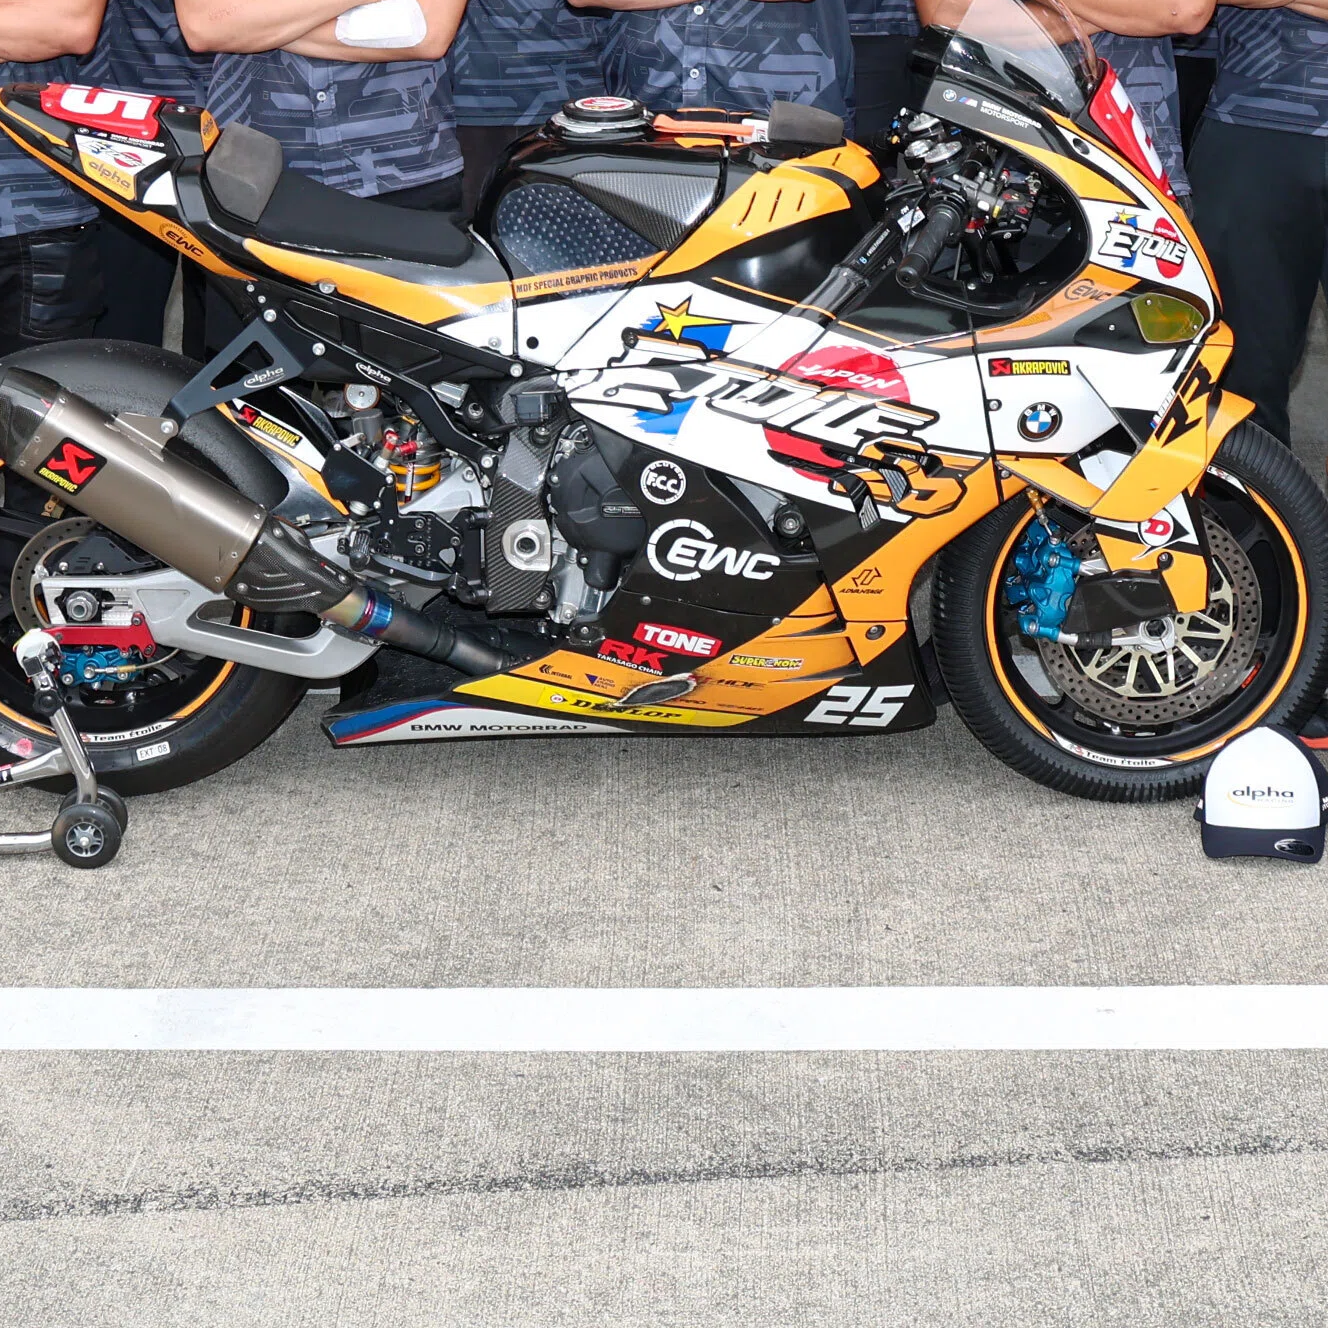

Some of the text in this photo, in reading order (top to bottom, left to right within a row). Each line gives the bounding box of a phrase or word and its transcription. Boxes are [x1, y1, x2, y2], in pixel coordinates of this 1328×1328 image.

[979, 106, 1030, 129] MOTORSPORT
[88, 160, 131, 188] alpha
[165, 230, 204, 257] EWC
[1098, 220, 1188, 265] ETOILE
[516, 267, 639, 294] MDF SPECIAL GRAPHIC PRODUCTS
[1075, 285, 1111, 302] EWC
[246, 367, 284, 385] alpha
[358, 362, 392, 384] alpha
[798, 364, 901, 390] JAPON
[562, 328, 939, 448] ETOILE
[666, 536, 781, 580] EWC
[643, 623, 716, 655] TONE
[596, 653, 664, 676] TAKASAGO CHAIN
[598, 638, 669, 671] RK
[732, 655, 765, 667] SUPER
[803, 683, 915, 727] 25
[93, 734, 126, 742] Team
[411, 724, 588, 732] BMW MOTORRAD
[139, 745, 168, 759] EXT 08
[1086, 751, 1117, 765] Team
[1232, 786, 1294, 801] alpha
